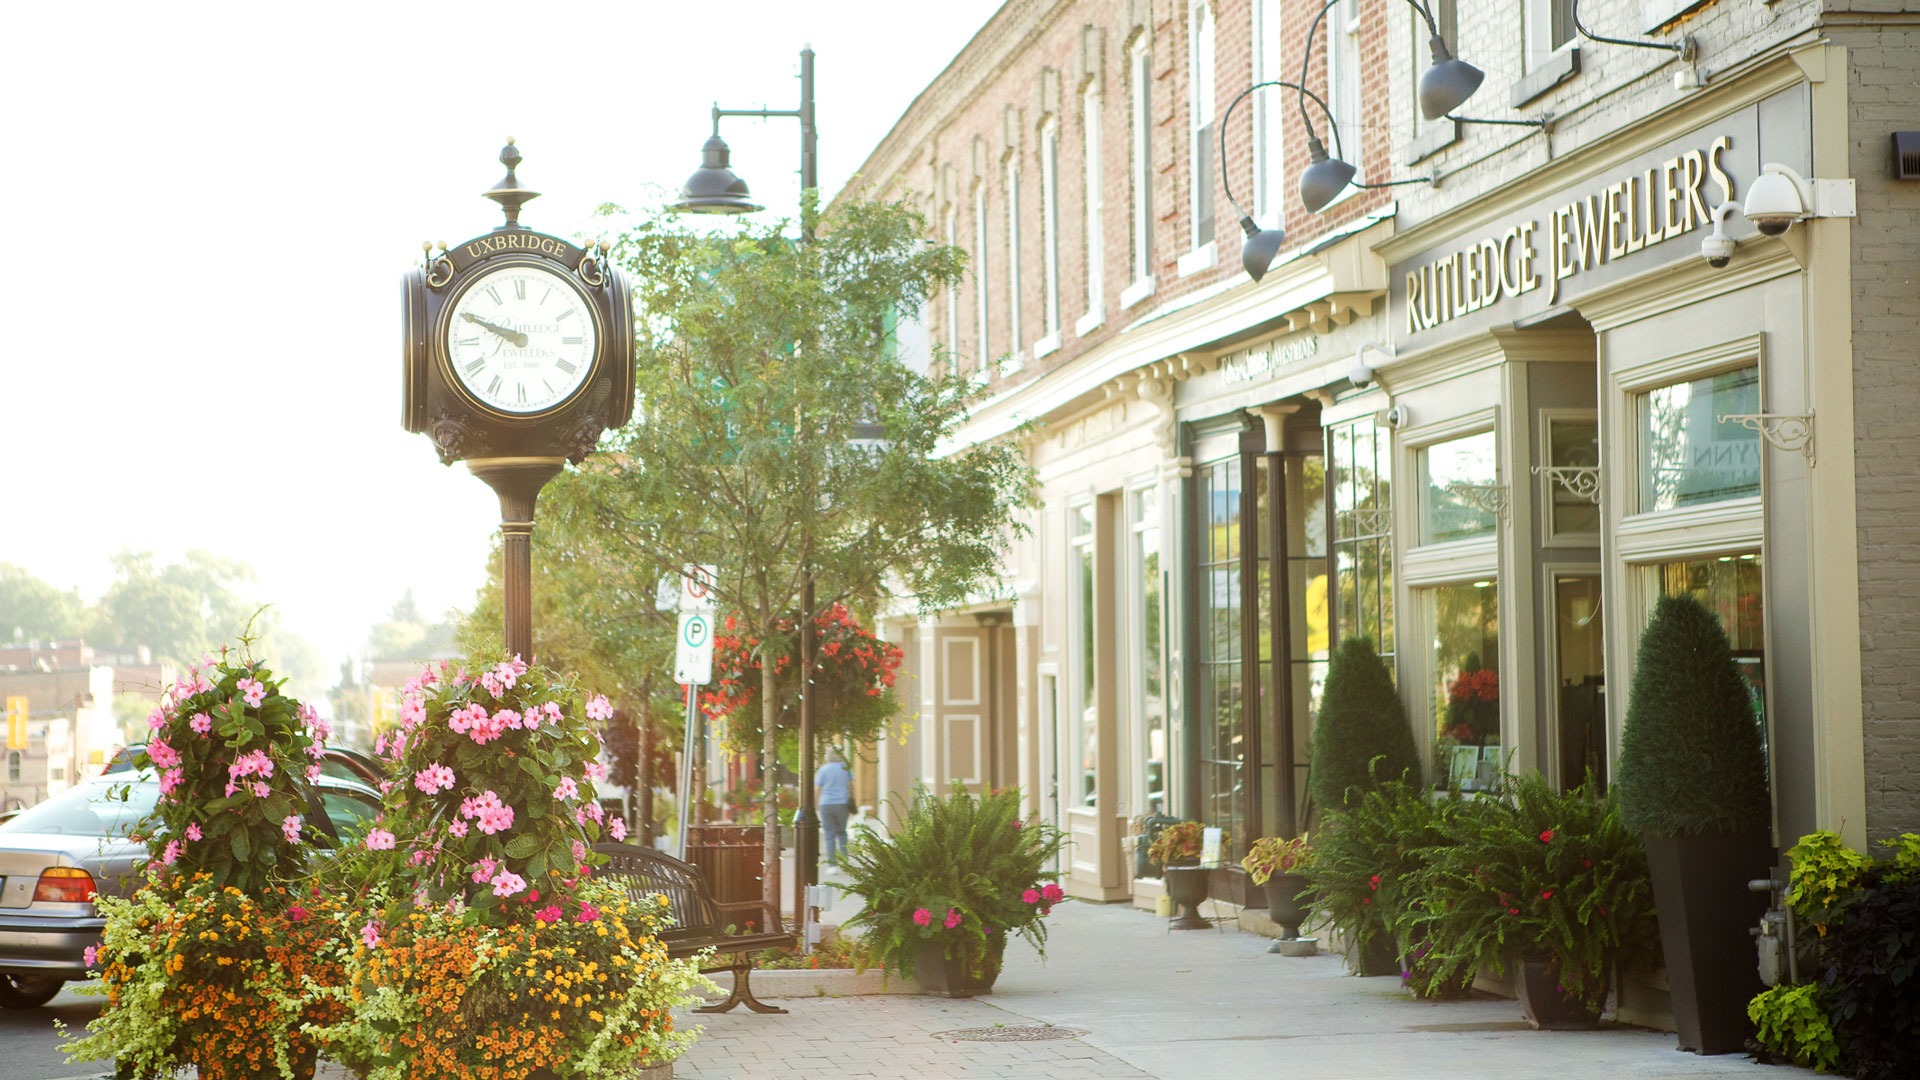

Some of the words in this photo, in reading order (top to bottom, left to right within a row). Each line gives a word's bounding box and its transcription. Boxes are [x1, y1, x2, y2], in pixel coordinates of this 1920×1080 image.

[467, 234, 567, 259] UXBRIDGE
[1405, 220, 1540, 334] RUTLEDGE
[1547, 135, 1734, 306] JEWELLERS
[691, 623, 702, 639] P
